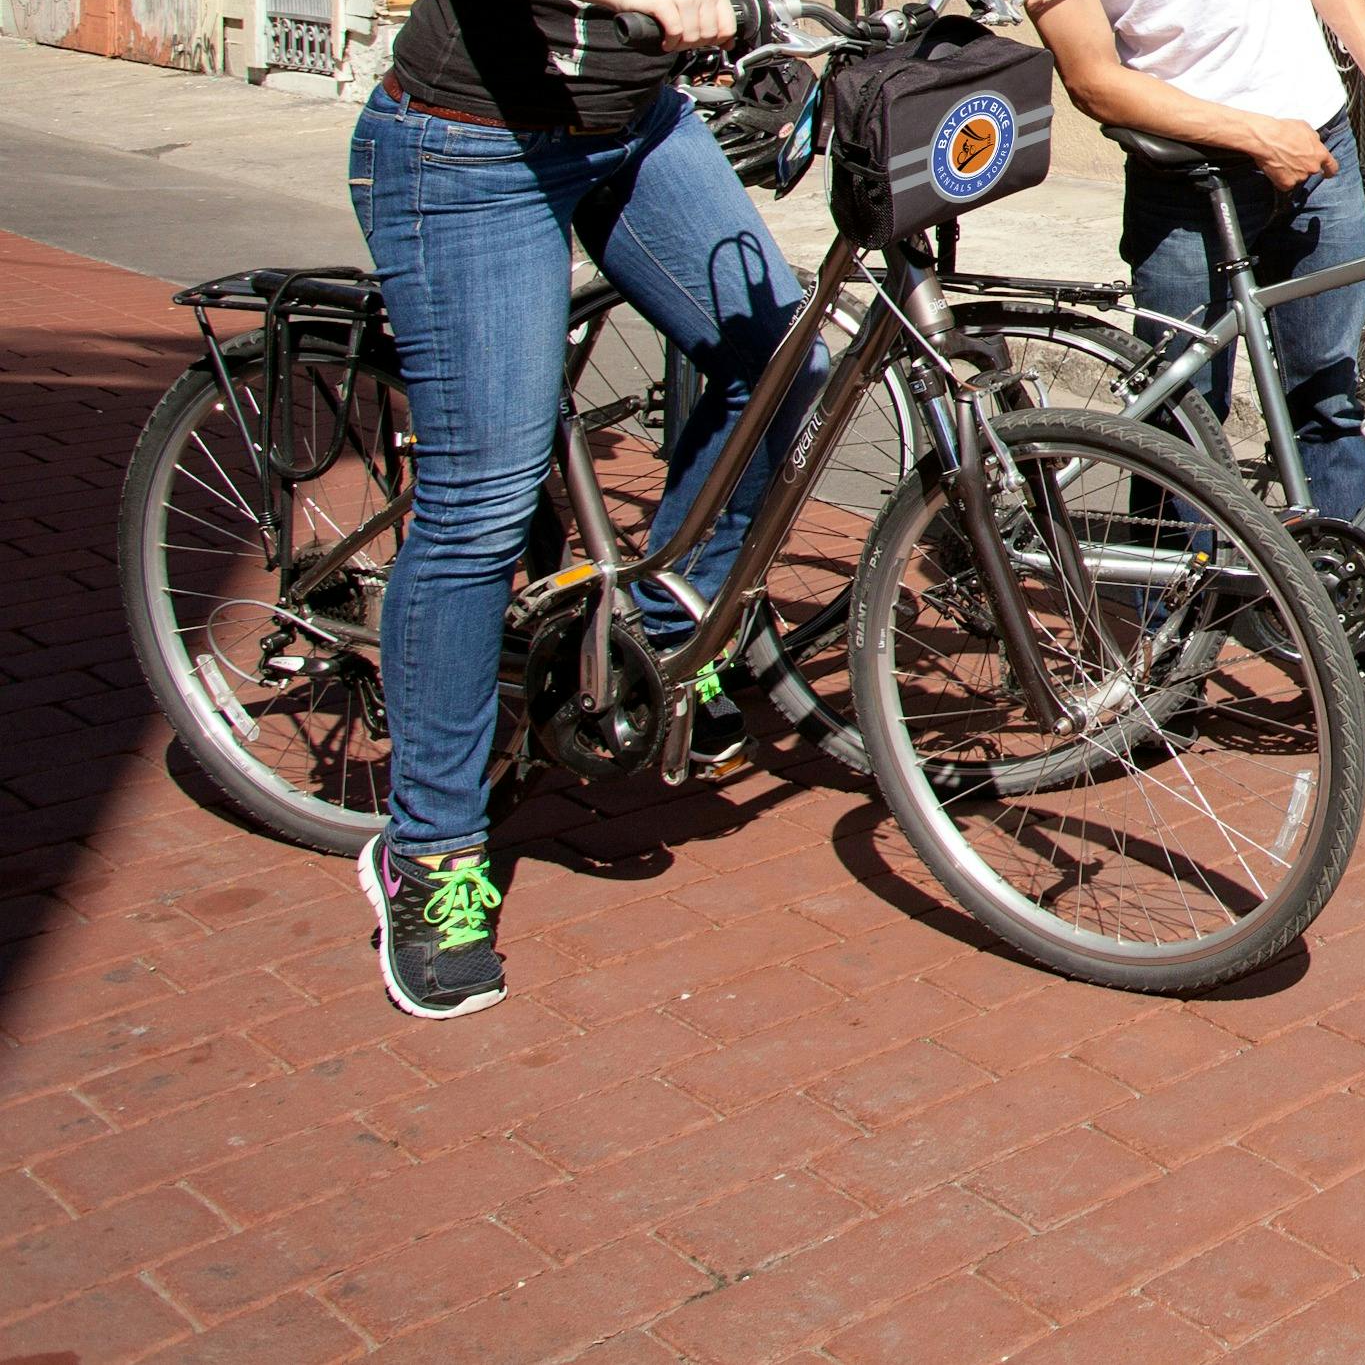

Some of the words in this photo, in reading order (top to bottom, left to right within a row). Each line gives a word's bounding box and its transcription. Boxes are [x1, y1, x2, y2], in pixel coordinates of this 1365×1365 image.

[938, 117, 956, 149] BAY
[960, 100, 988, 117] CITY
[990, 102, 1010, 130] BIKE
[937, 166, 972, 192] RENTALS
[986, 143, 1009, 179] TOURS
[793, 412, 822, 468] giant
[856, 601, 868, 648] GIANT
